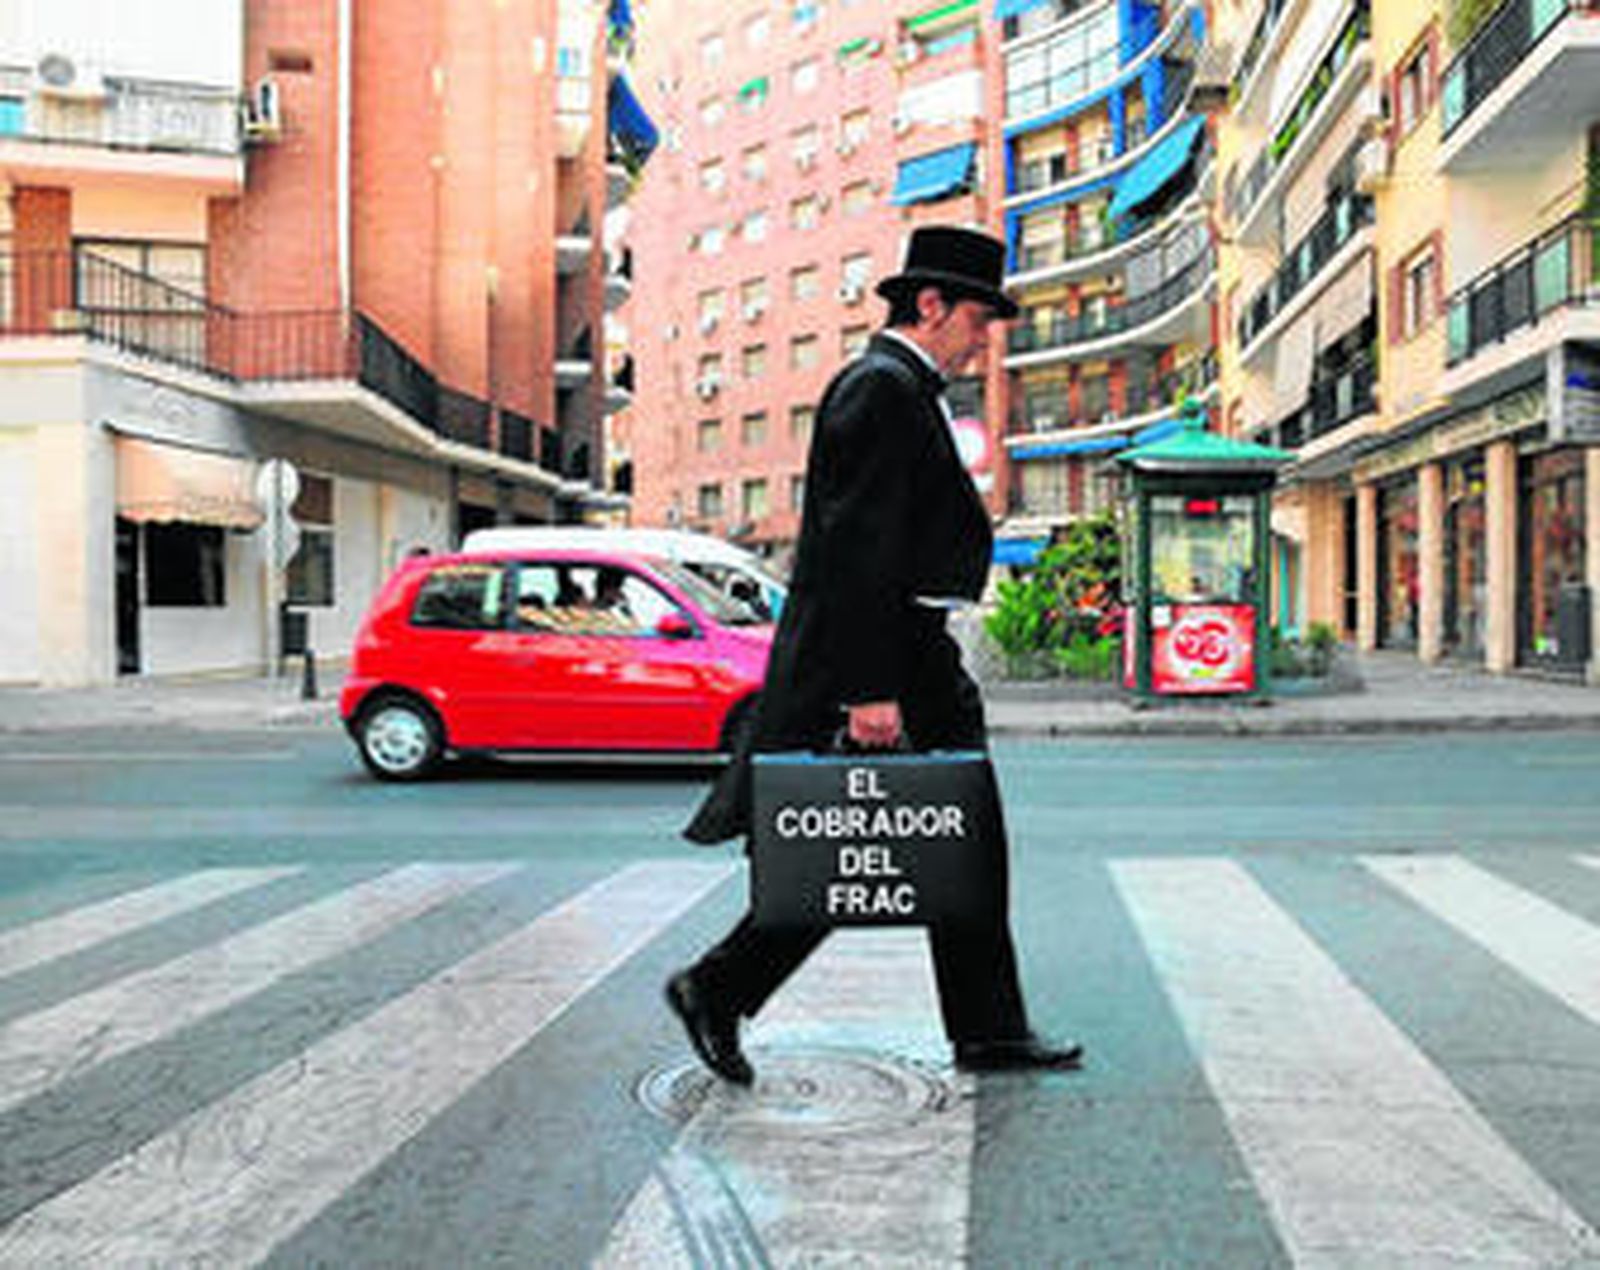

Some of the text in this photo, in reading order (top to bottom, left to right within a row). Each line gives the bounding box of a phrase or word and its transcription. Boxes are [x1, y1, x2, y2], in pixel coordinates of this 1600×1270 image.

[847, 768, 887, 799] EL
[776, 806, 965, 838] COBRADOR
[839, 846, 902, 876] DEL
[827, 884, 915, 914] FRAC
